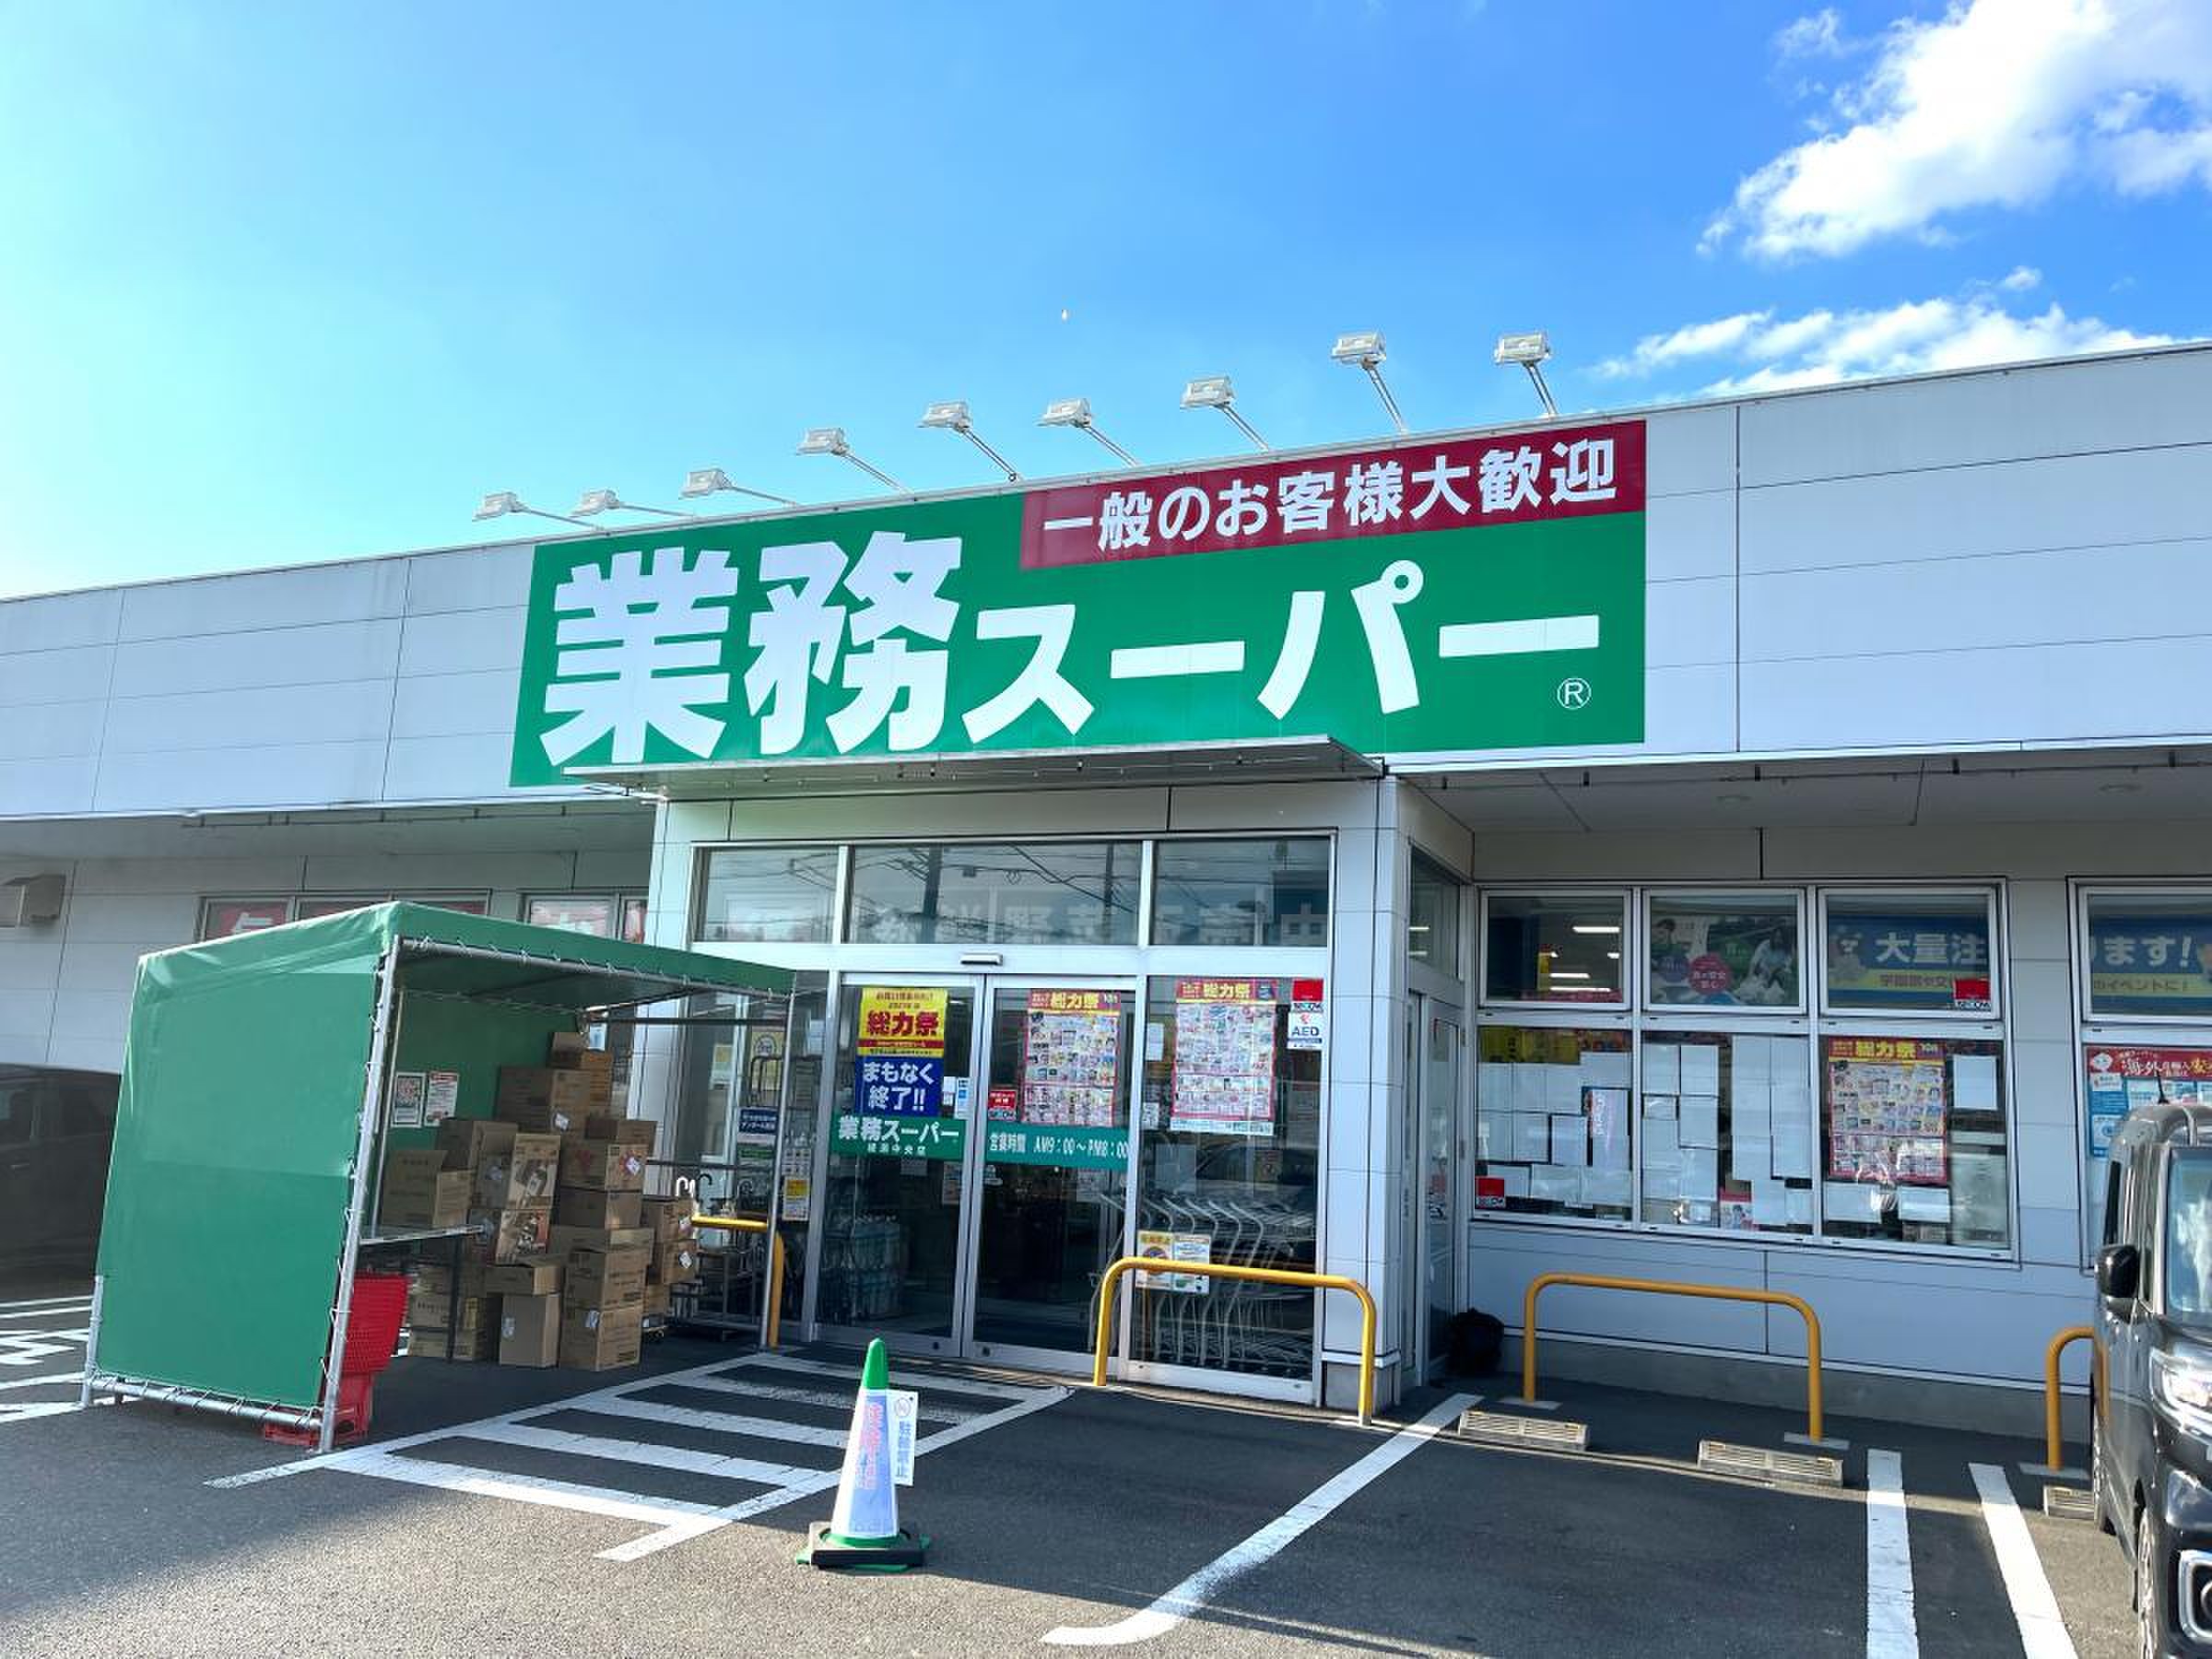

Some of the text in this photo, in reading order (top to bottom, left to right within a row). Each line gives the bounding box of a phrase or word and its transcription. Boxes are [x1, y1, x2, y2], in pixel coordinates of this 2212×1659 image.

[1043, 438, 1618, 552] 一般のお客様大歓迎
[539, 530, 1600, 766] 業務スーパー
[866, 1009, 939, 1037] 総力祭
[1291, 1026, 1320, 1037] AED
[864, 1061, 935, 1085] まもなく
[868, 1085, 926, 1112] 終了!!
[838, 1114, 959, 1143] 業務スーパー
